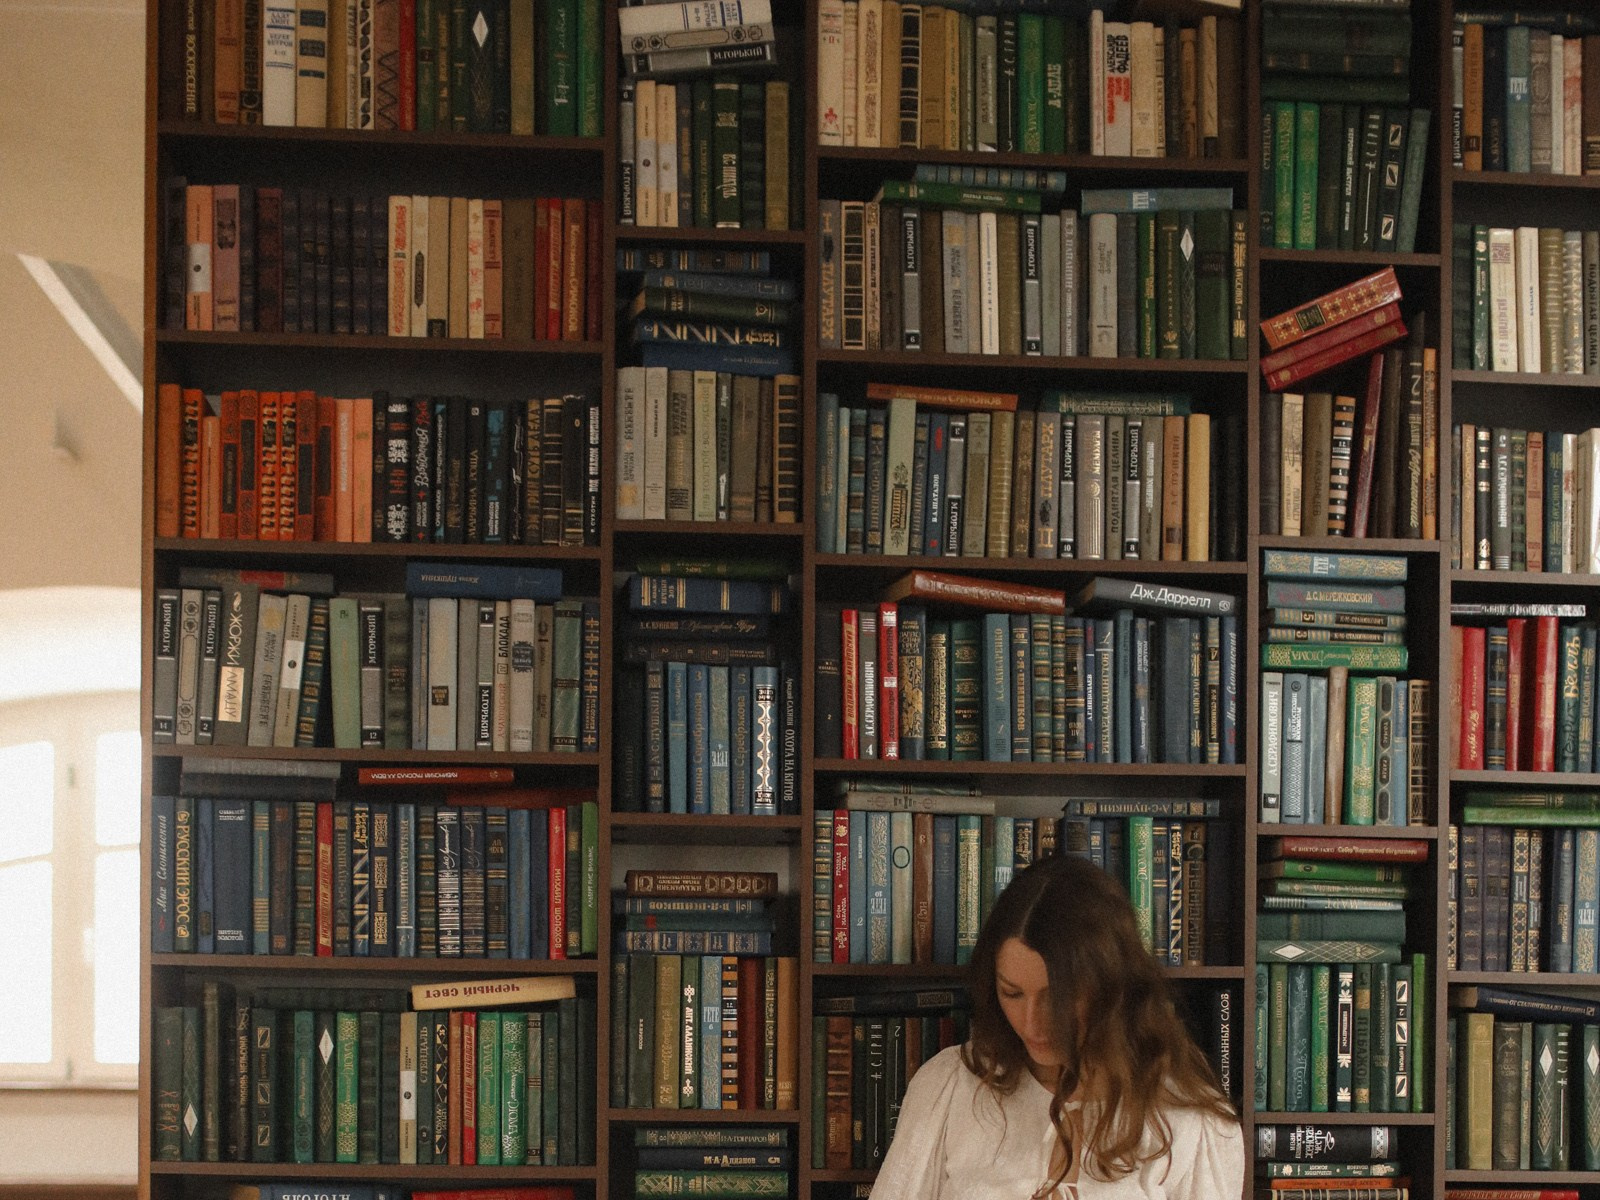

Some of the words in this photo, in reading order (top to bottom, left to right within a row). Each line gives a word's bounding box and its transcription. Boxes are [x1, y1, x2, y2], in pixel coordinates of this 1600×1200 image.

[186, 34, 196, 113] ВОСКРЕСЕНИЕ
[1115, 34, 1129, 74] ФАДЕЕВ
[568, 278, 580, 331] СИМОНОВ
[822, 262, 835, 341] ПЛУТАРХ
[468, 449, 478, 481] РОЩА
[1040, 421, 1054, 499] ПЛУТАРХ
[1110, 429, 1121, 474] ЦЕЛИНА
[468, 487, 478, 539] МАРЬИНА
[891, 489, 902, 529] ШИПКА
[1110, 476, 1120, 534] ПОДНЯТАЯ
[226, 613, 243, 665] ЖОРЖИ
[498, 615, 510, 658] БЛОКАДА
[784, 728, 795, 758] ОХОТА
[784, 759, 795, 771] НА
[784, 771, 795, 801] КИТОВ
[176, 825, 192, 884] РУССКИЙ
[176, 887, 192, 924] ЭРОС
[554, 868, 563, 904] МИХАИЛ
[554, 907, 562, 948] ШОЛОХОВ
[1221, 993, 1231, 1021] СЛОВ
[419, 1026, 429, 1084] СТЕНДАЛЬ
[1221, 1023, 1230, 1094] НОСТРАННЫХ
